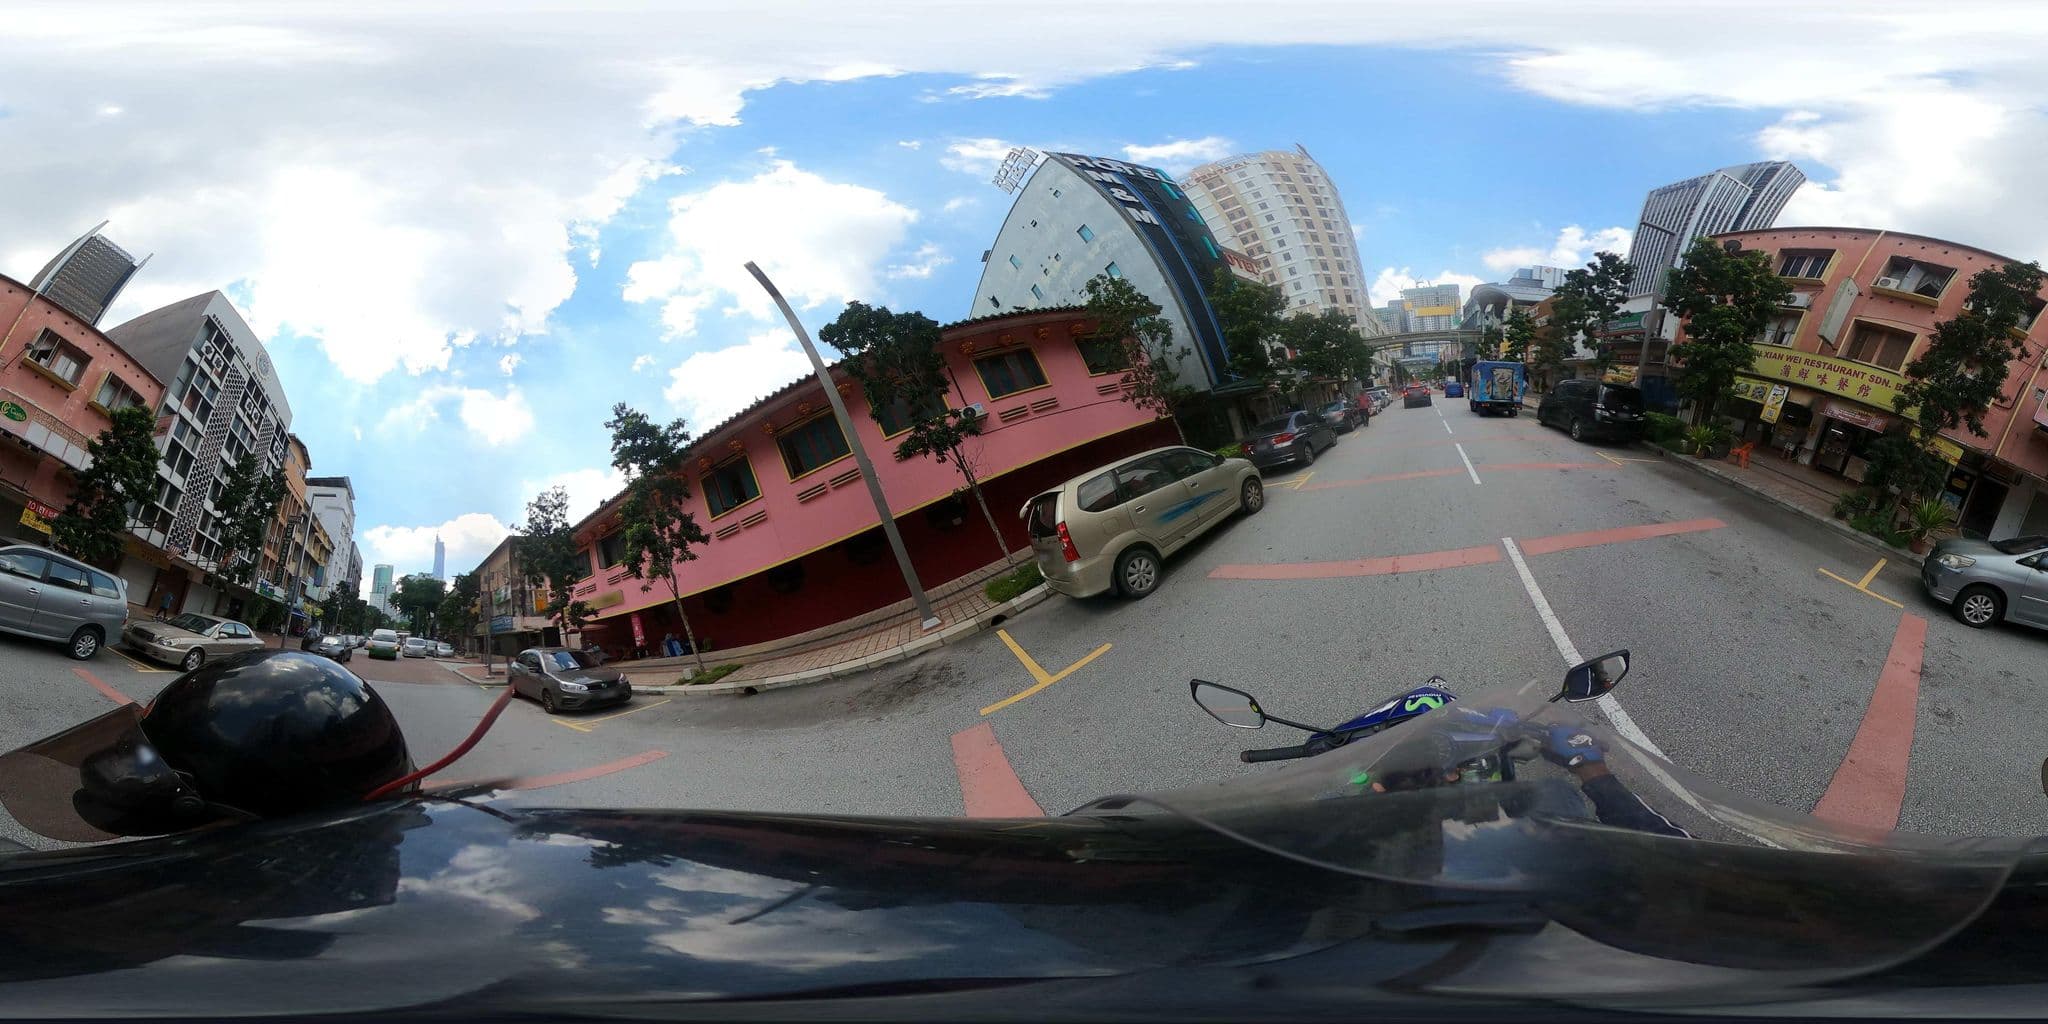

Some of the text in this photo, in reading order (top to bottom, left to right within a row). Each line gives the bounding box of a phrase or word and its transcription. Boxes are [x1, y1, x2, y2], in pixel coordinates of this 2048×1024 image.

[1064, 156, 1177, 186] HOTEL
[1223, 252, 1260, 275] OTEL
[1764, 351, 1785, 361] XIAN
[1785, 354, 1803, 364] WEI
[1803, 358, 1867, 380] RESTAURANT
[1868, 374, 1891, 388] SDN.
